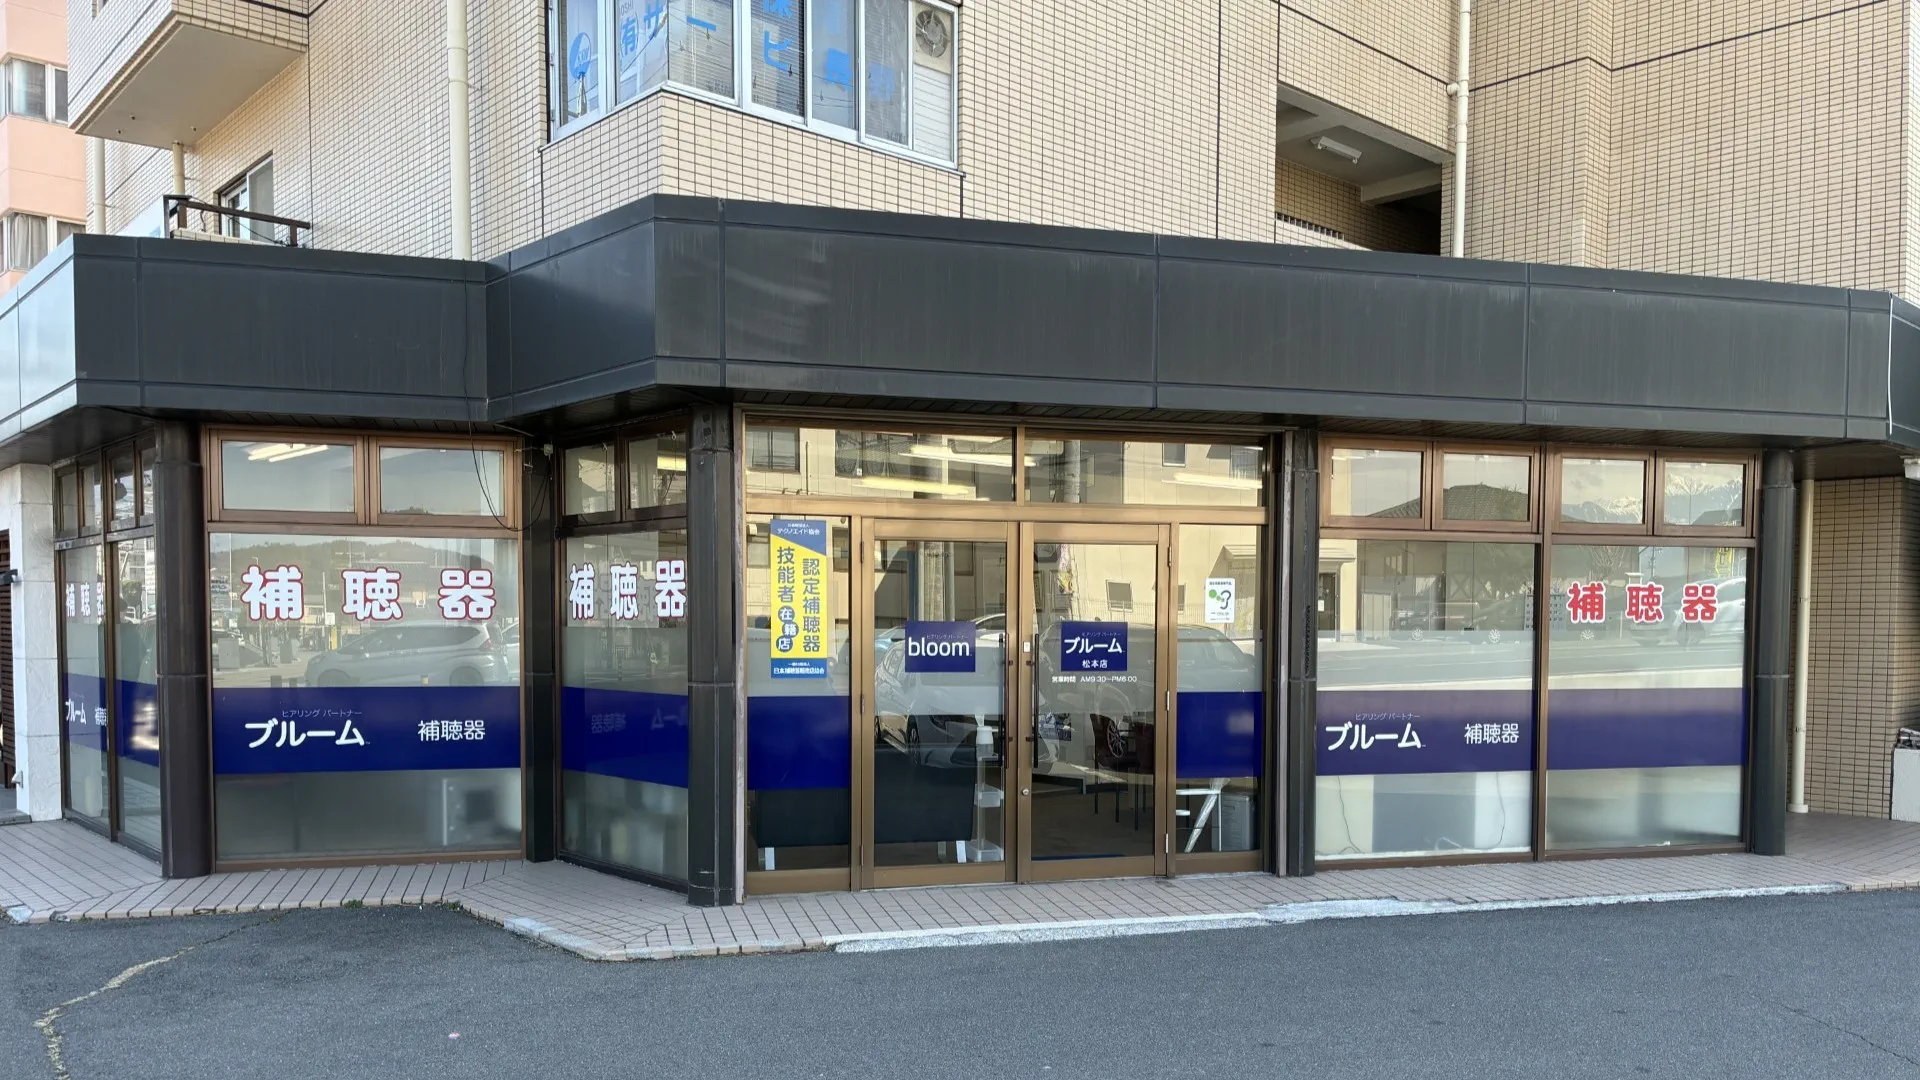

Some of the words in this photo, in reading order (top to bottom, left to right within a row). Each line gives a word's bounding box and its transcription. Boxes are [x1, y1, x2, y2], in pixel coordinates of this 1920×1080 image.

[241, 564, 496, 621] 補聴器
[569, 559, 687, 621] 補聴器
[803, 558, 820, 652] 認定補聴器
[1566, 582, 1718, 624] 補聴器
[908, 636, 970, 657] bloom
[1064, 636, 1122, 654] ブルーム
[1082, 659, 1108, 669] 松本店
[282, 709, 320, 718] ヒアリング
[323, 709, 362, 718] パートナー
[1355, 713, 1387, 721] ヒアリング
[245, 718, 365, 749] ブルーム
[417, 719, 487, 742] 補聴器
[1325, 721, 1421, 751] ブルーム
[1464, 722, 1520, 745] 補聴器
